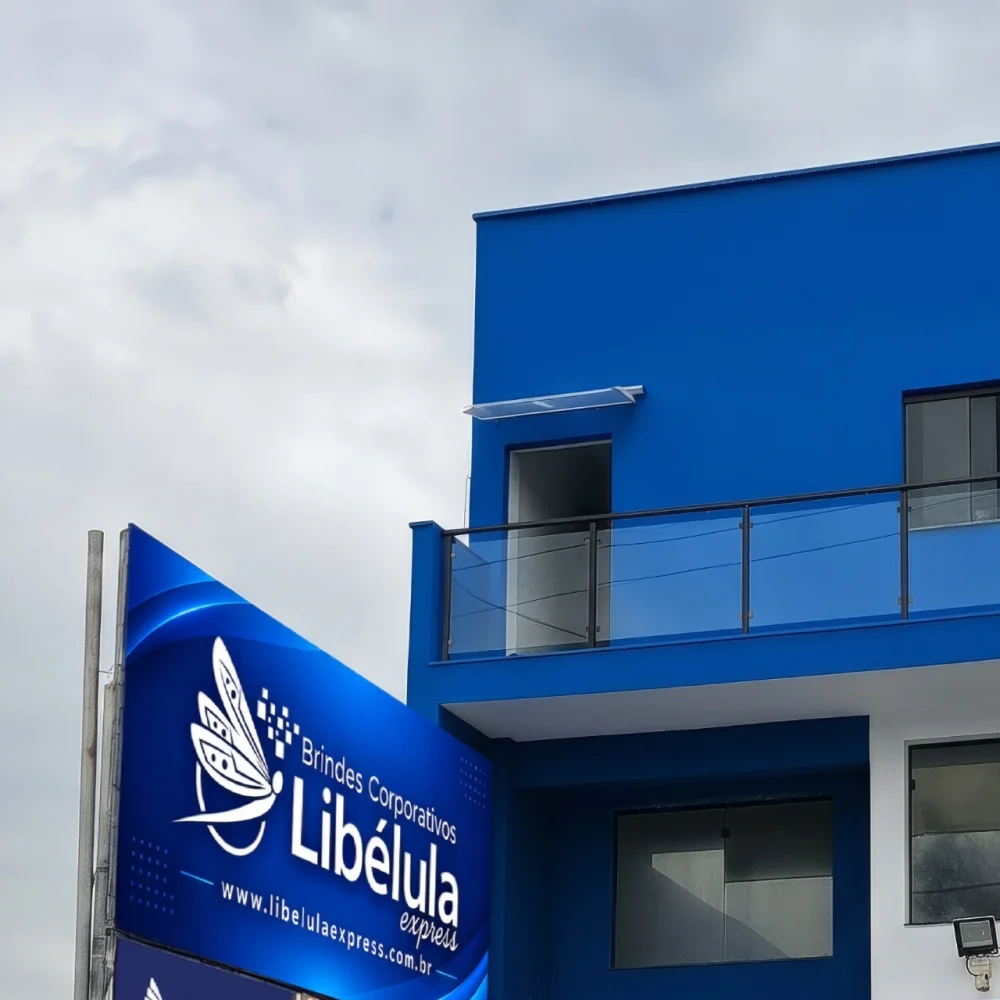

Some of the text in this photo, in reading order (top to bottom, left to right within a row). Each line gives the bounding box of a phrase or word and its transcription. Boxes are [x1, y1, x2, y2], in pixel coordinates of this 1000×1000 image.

[302, 736, 457, 845] Brindes Corporativos
[290, 776, 459, 926] Libélula
[221, 881, 432, 976] www.libelulaexpress.com.br
[400, 911, 459, 951] express
